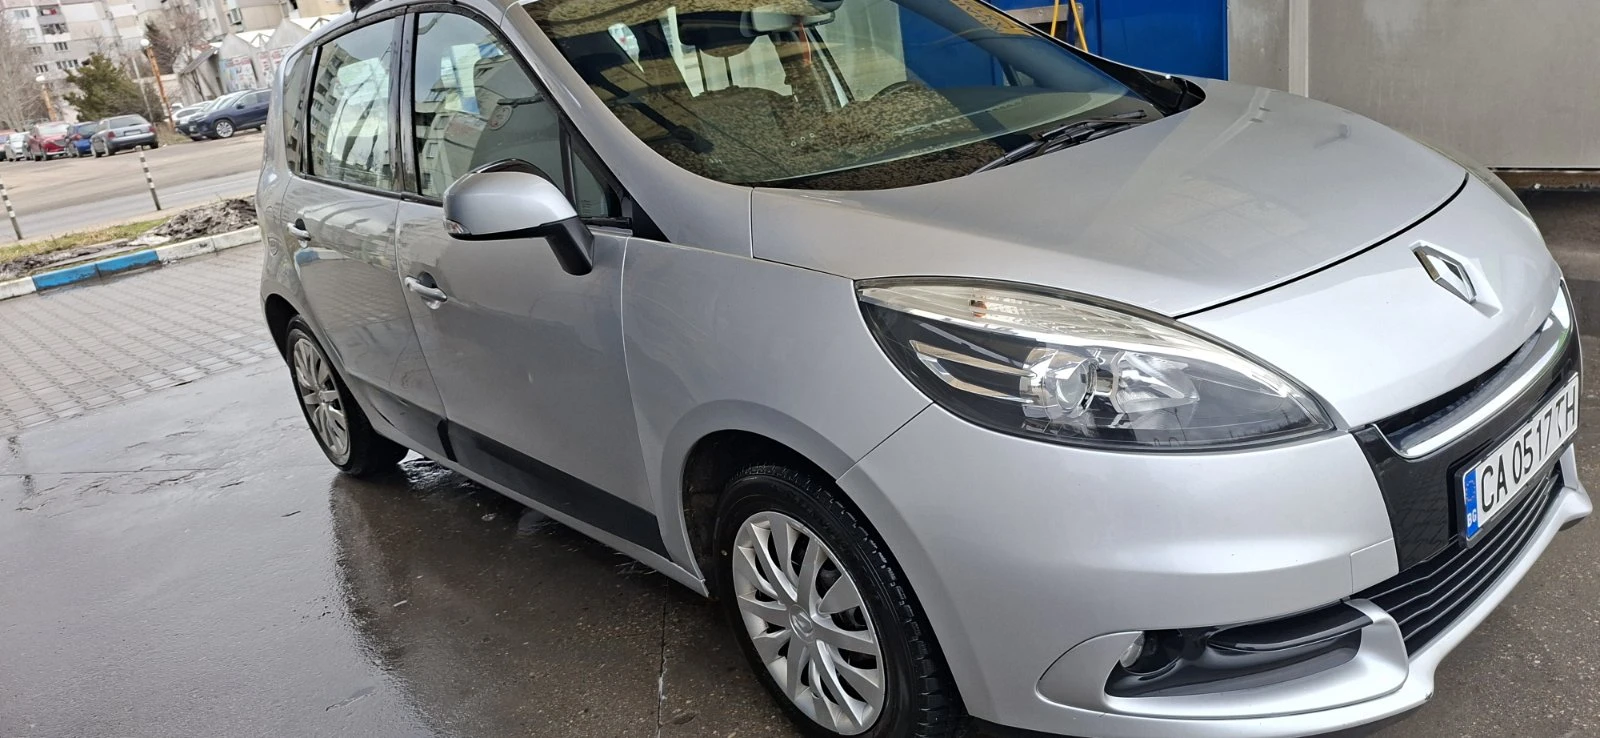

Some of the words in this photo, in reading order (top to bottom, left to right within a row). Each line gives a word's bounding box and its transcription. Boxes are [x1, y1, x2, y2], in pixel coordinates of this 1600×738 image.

[1481, 454, 1508, 513] CA
[1512, 407, 1552, 484] 0517
[1556, 385, 1576, 439] TH
[1467, 508, 1477, 526] BG
